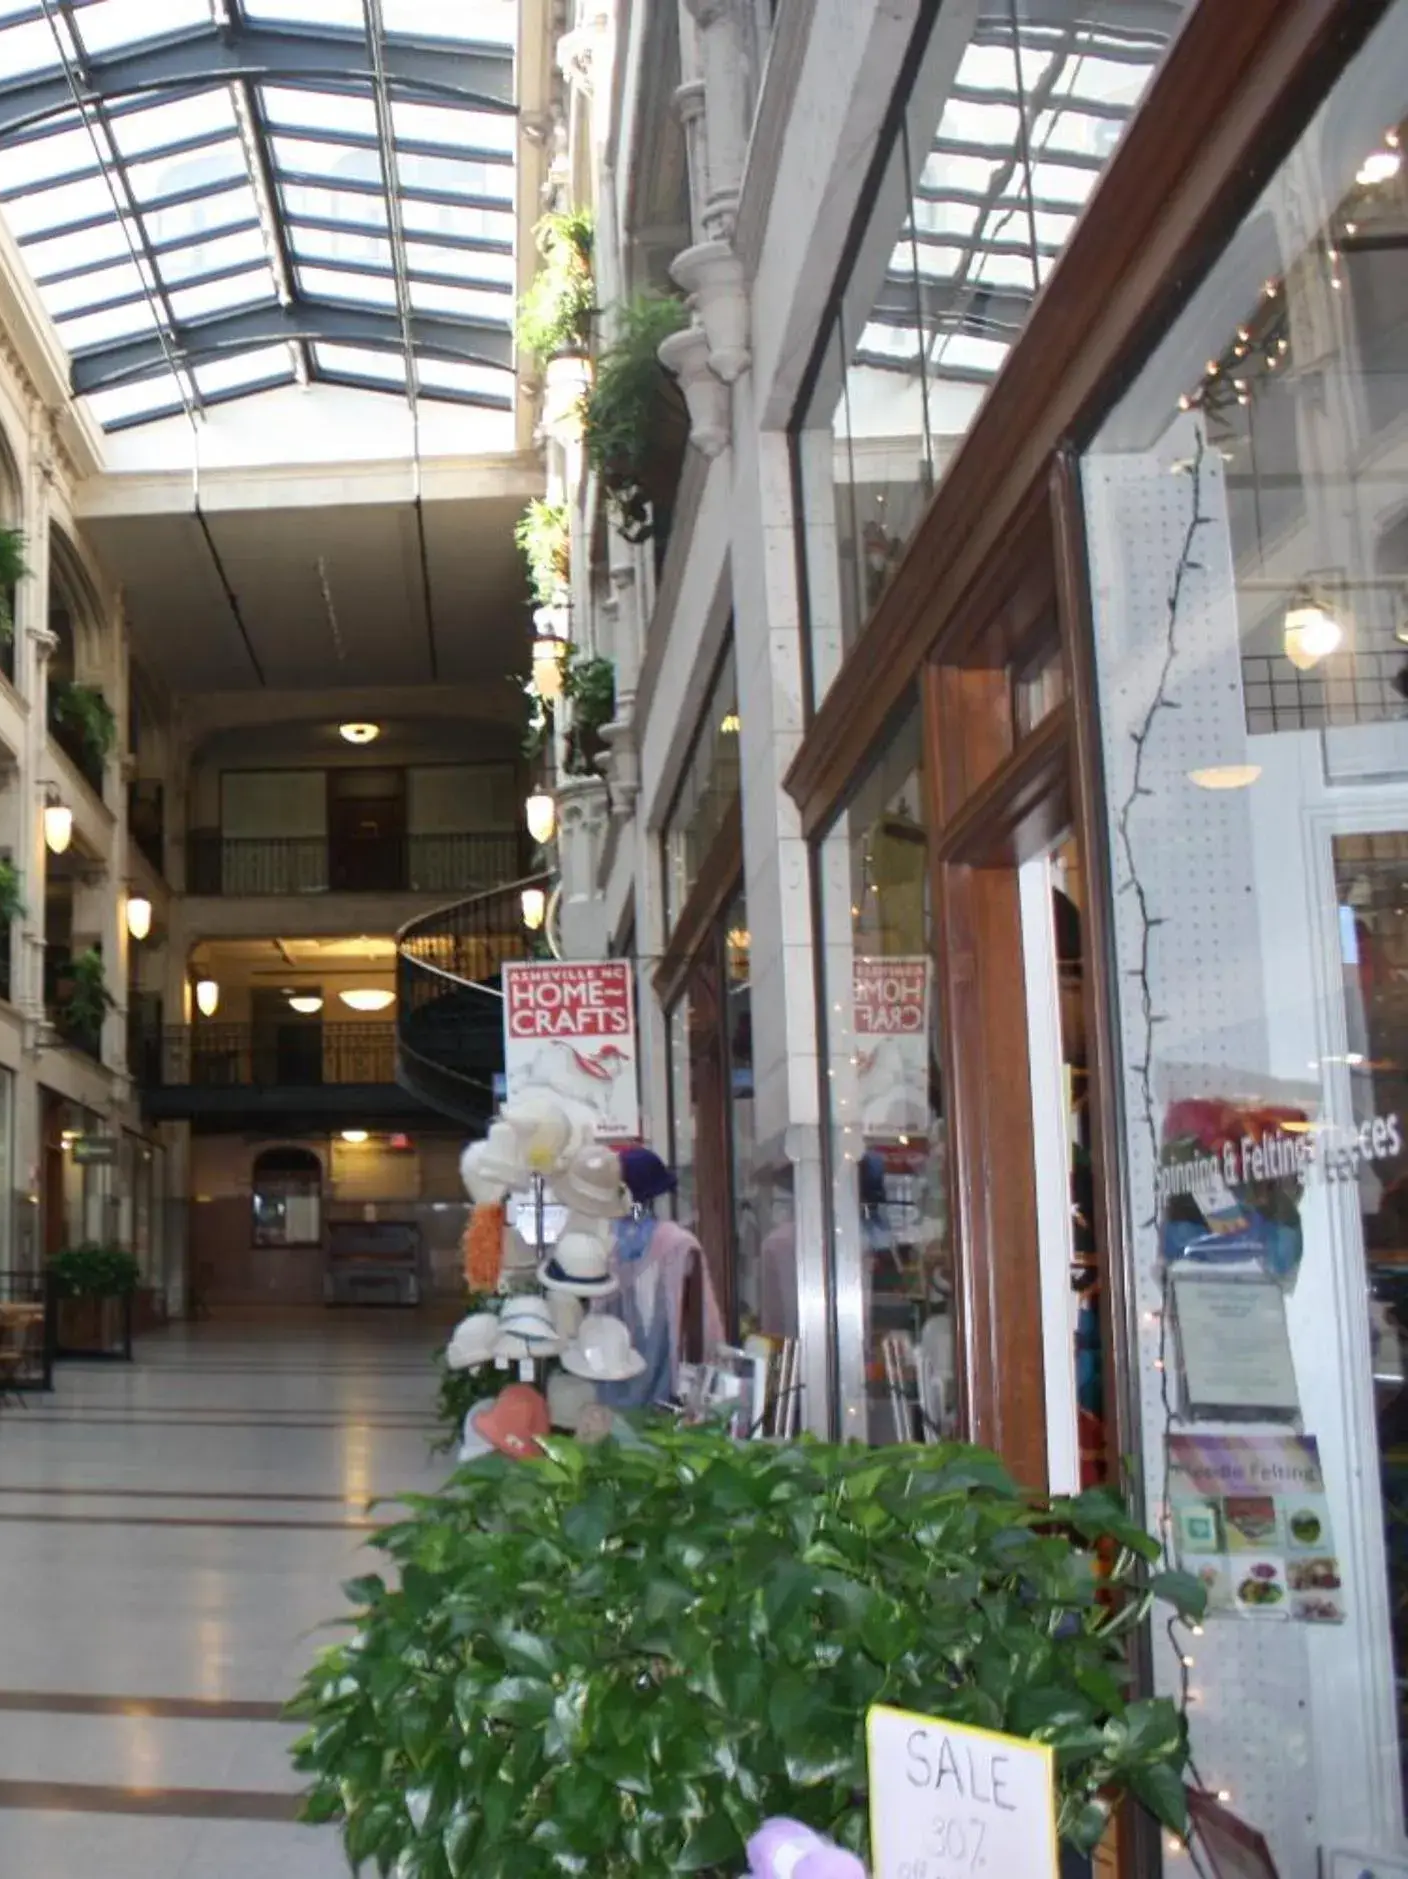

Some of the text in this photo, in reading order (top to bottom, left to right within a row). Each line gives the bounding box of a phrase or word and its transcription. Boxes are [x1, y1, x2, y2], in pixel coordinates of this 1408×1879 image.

[511, 965, 624, 981] ASHEVILLE NC
[512, 1007, 626, 1035] CRAFTS
[906, 1729, 1018, 1812] SALE
